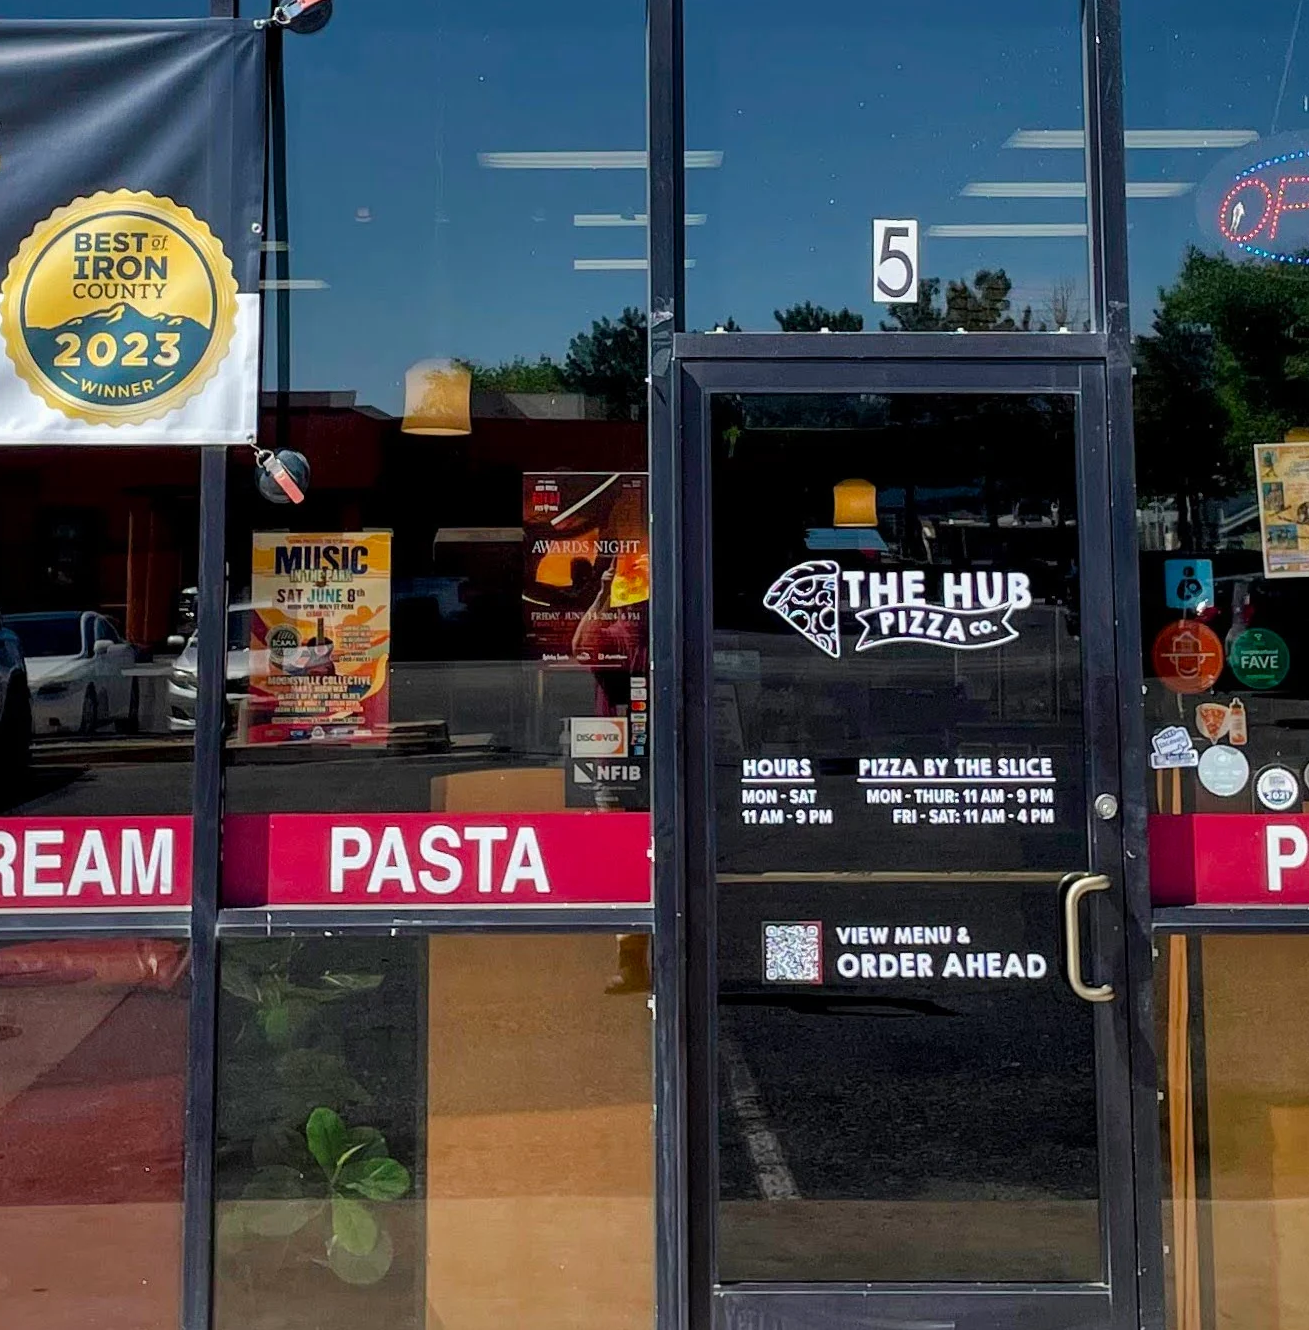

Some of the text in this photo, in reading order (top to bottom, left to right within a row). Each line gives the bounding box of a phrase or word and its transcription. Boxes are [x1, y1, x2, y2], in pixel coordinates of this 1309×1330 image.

[74, 232, 169, 253] BEST of
[72, 255, 168, 281] IRON
[877, 226, 914, 298] 5
[72, 282, 168, 300] COUNTY
[53, 332, 181, 367] 2023
[80, 377, 155, 398] WINNER
[532, 539, 641, 554] AWARDS NIGHT
[275, 545, 369, 574] MUSIC
[276, 588, 366, 603] SAT JUNE 8th
[842, 570, 1032, 609] THE HUB
[531, 611, 561, 621] FRIDAY
[879, 610, 998, 642] PIZZA CO.
[1241, 655, 1279, 669] FAVE
[576, 733, 619, 742] DISCOVER
[597, 765, 641, 781] NFIB
[742, 758, 812, 777] HOURS
[858, 758, 1053, 776] PIZZA BY THE SLICE
[742, 789, 778, 804] MON
[790, 789, 817, 804] SAT
[866, 789, 902, 804] MON
[914, 789, 959, 804] THUR:
[963, 789, 978, 804] 11
[980, 789, 1004, 804] AM
[1016, 789, 1027, 804] 9
[1030, 789, 1054, 804] PM
[742, 809, 757, 824] 11
[759, 809, 784, 824] AM
[795, 809, 806, 824] 9
[809, 809, 833, 824] PM
[892, 809, 917, 824] FRI
[929, 809, 960, 824] SAT:
[963, 809, 978, 824] 11
[981, 809, 1005, 824] AM
[1017, 809, 1027, 824] 4
[1031, 809, 1054, 824] PM
[329, 825, 547, 895] PASTA
[836, 926, 971, 944] VIEW MENU &
[836, 952, 1048, 978] ORDER AHEAD
